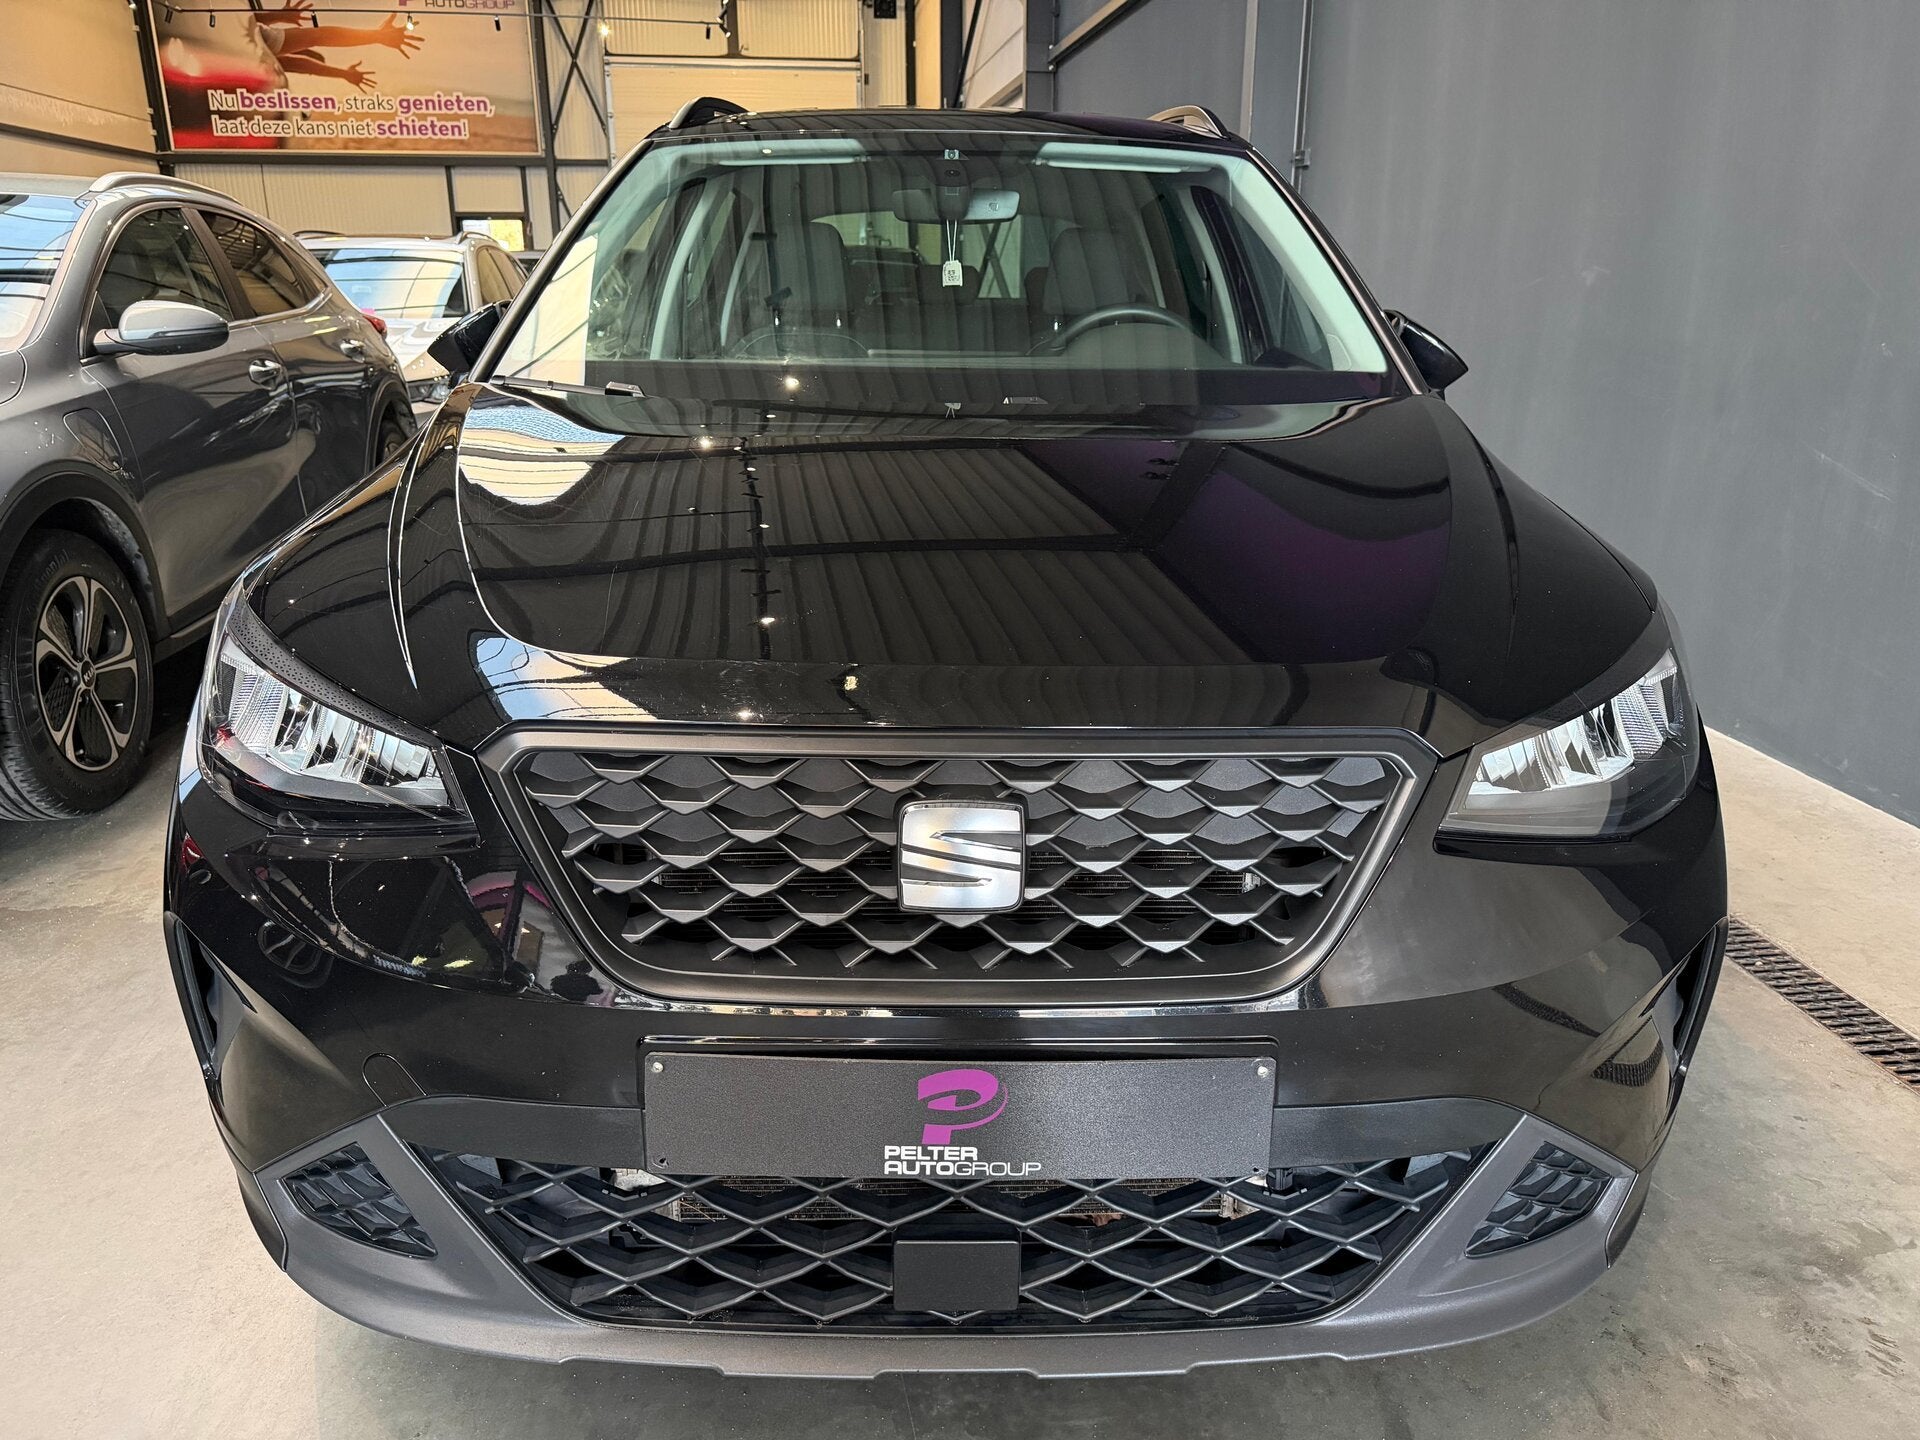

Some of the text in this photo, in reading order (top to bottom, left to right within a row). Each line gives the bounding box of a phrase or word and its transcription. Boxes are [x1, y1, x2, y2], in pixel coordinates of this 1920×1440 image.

[425, 0, 515, 9] AUTOGROUP
[209, 90, 493, 114] Nu beslissen, straks genieten,
[214, 116, 468, 137] laat deze kans niet schieten!
[884, 1145, 978, 1161] PELTER
[884, 1160, 1042, 1176] AUTOGROUP
